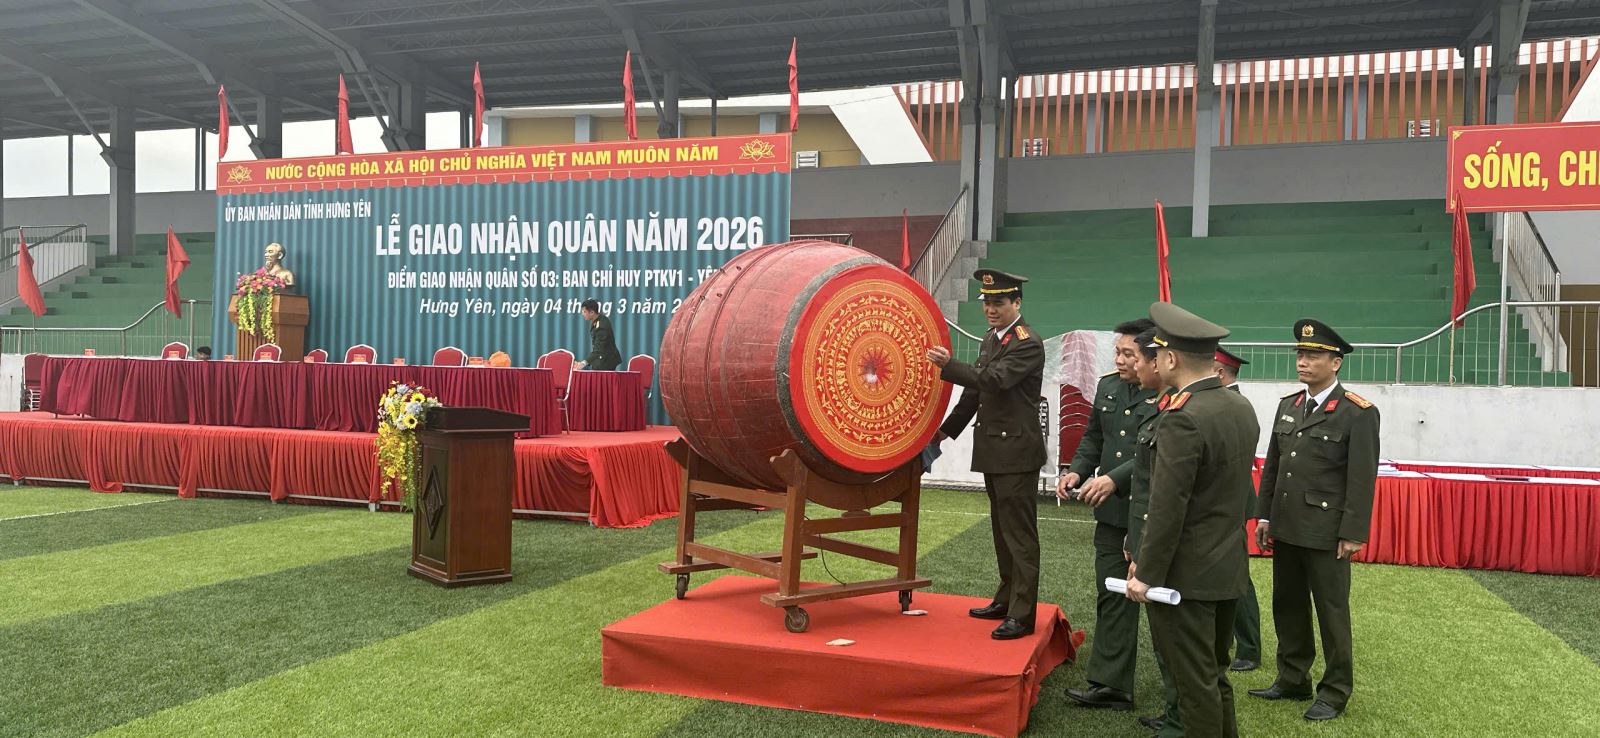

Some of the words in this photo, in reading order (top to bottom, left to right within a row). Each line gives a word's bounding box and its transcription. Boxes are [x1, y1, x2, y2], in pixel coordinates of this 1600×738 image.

[265, 163, 303, 180] NƯỚC
[308, 162, 345, 179] CỘNG
[350, 158, 379, 175] HÒA
[384, 155, 404, 174] XÃ
[409, 156, 434, 176] HỘI
[440, 152, 471, 172] CHỦ
[476, 151, 526, 169] NGHĨA
[532, 150, 566, 170] VIỆT
[572, 151, 611, 166] NAM
[617, 147, 669, 164] MUÔN
[676, 144, 718, 161] NĂM
[1464, 141, 1548, 191] SỐNG,
[1559, 151, 1600, 186] CH
[238, 207, 255, 221] BAN
[257, 203, 281, 220] NHÂN
[283, 202, 301, 219] DÂN
[304, 199, 323, 219] TỈNH
[326, 202, 350, 218] HƯNG
[353, 199, 370, 217] YÊN
[376, 213, 400, 255] LỄ
[409, 223, 462, 255] GIAO
[471, 215, 538, 260] NHẬN
[548, 213, 616, 256] QUÂN
[627, 211, 687, 251] NĂM
[697, 216, 763, 250] 2026
[388, 266, 416, 288] ĐIỂM
[420, 272, 445, 288] GIAO
[450, 268, 481, 291] NHẬN
[486, 268, 517, 289] QUÂN
[522, 265, 537, 287] SỐ
[541, 271, 558, 287] 03:
[563, 271, 587, 287] BAN
[592, 265, 612, 287] CHỈ
[617, 270, 640, 287] HUY
[645, 270, 682, 286] PTKV1
[697, 264, 718, 284] YÊ
[420, 299, 458, 317] Hưng
[465, 298, 495, 316] Yên,
[502, 300, 539, 317] ngày
[544, 299, 561, 313] 04
[618, 299, 626, 313] 3
[632, 298, 666, 313] năm
